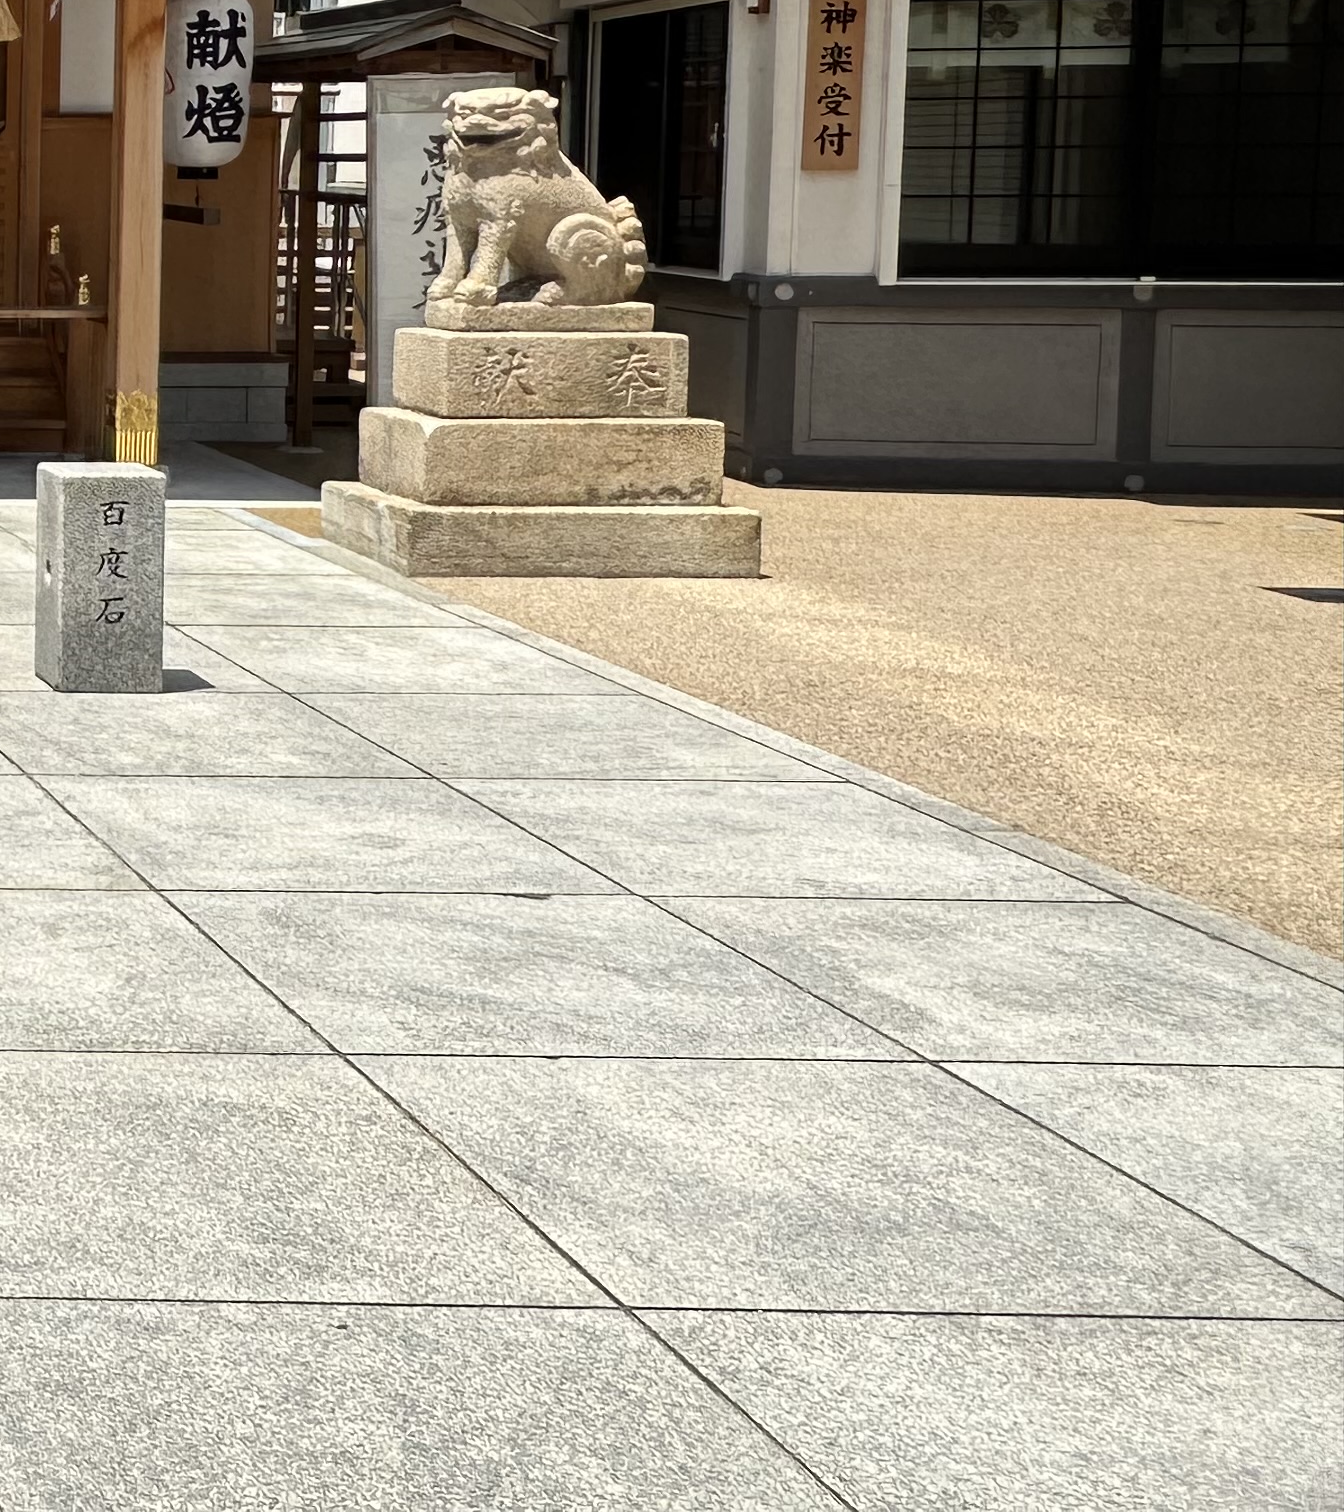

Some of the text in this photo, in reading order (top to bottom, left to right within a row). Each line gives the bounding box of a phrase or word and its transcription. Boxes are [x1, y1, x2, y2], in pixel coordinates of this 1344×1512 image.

[182, 8, 247, 143] 献燈
[813, 0, 858, 156] 神楽受付
[95, 500, 131, 624] 百度石
